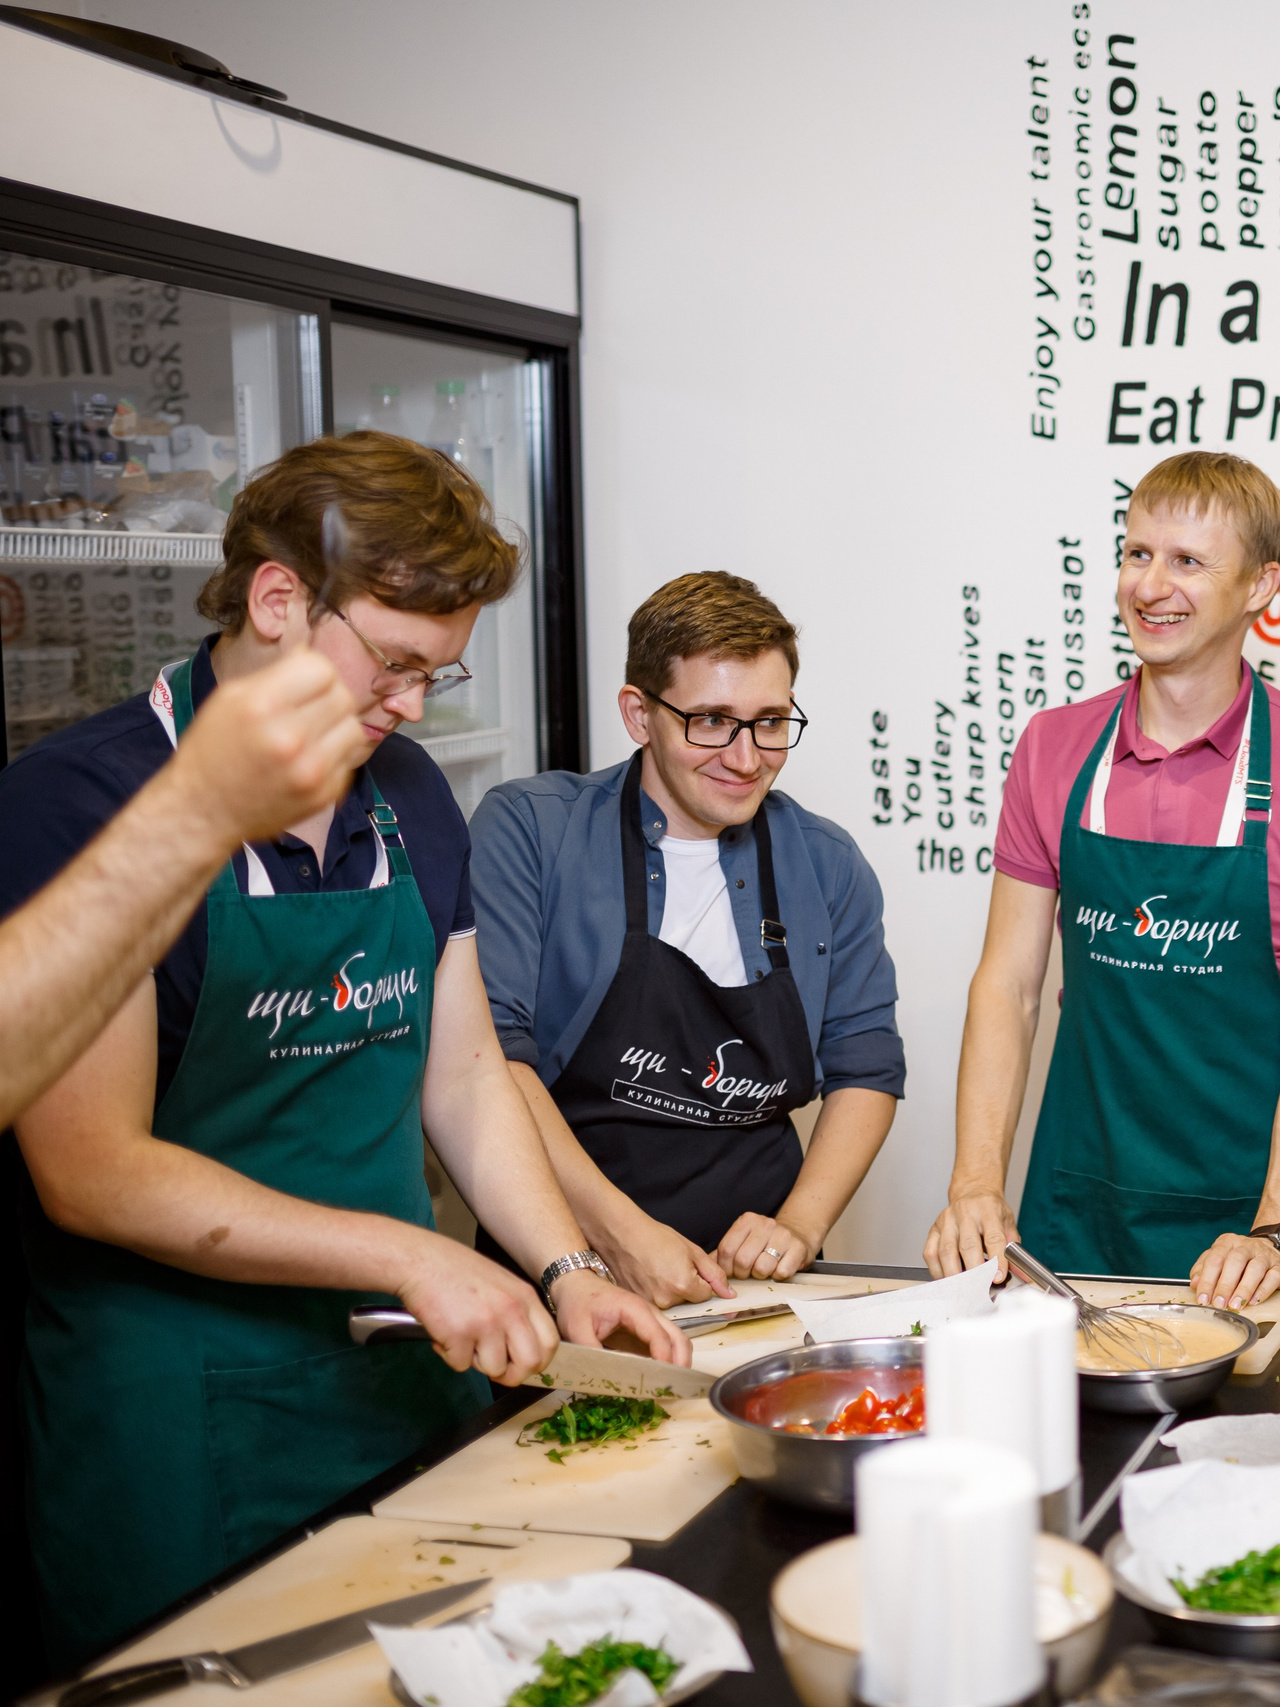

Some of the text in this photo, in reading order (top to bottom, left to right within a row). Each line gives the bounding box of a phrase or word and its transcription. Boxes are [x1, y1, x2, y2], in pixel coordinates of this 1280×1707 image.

[1101, 33, 1139, 245] Lemon
[1157, 97, 1186, 252] sugar
[1195, 90, 1226, 252] potato
[1237, 90, 1265, 250] pepper
[1026, 55, 1061, 441] Enjoy your talent
[1068, 86, 1096, 342] Gastronomic
[1121, 260, 1190, 348] In
[1219, 279, 1260, 345] a
[1107, 381, 1205, 445] Eat
[960, 584, 982, 708] knives
[1024, 637, 1047, 709] Salt
[869, 709, 892, 826] taste
[901, 757, 922, 825] You
[930, 700, 955, 830] cutlery
[964, 722, 987, 828] sharp
[916, 838, 964, 874] the
[1089, 951, 1224, 975] КУЛИНАРНАЯ СТУДИЯ
[269, 1037, 366, 1059] КУЛИНАРНАЯ
[627, 1088, 711, 1119] КУЛИНАРНАЯ
